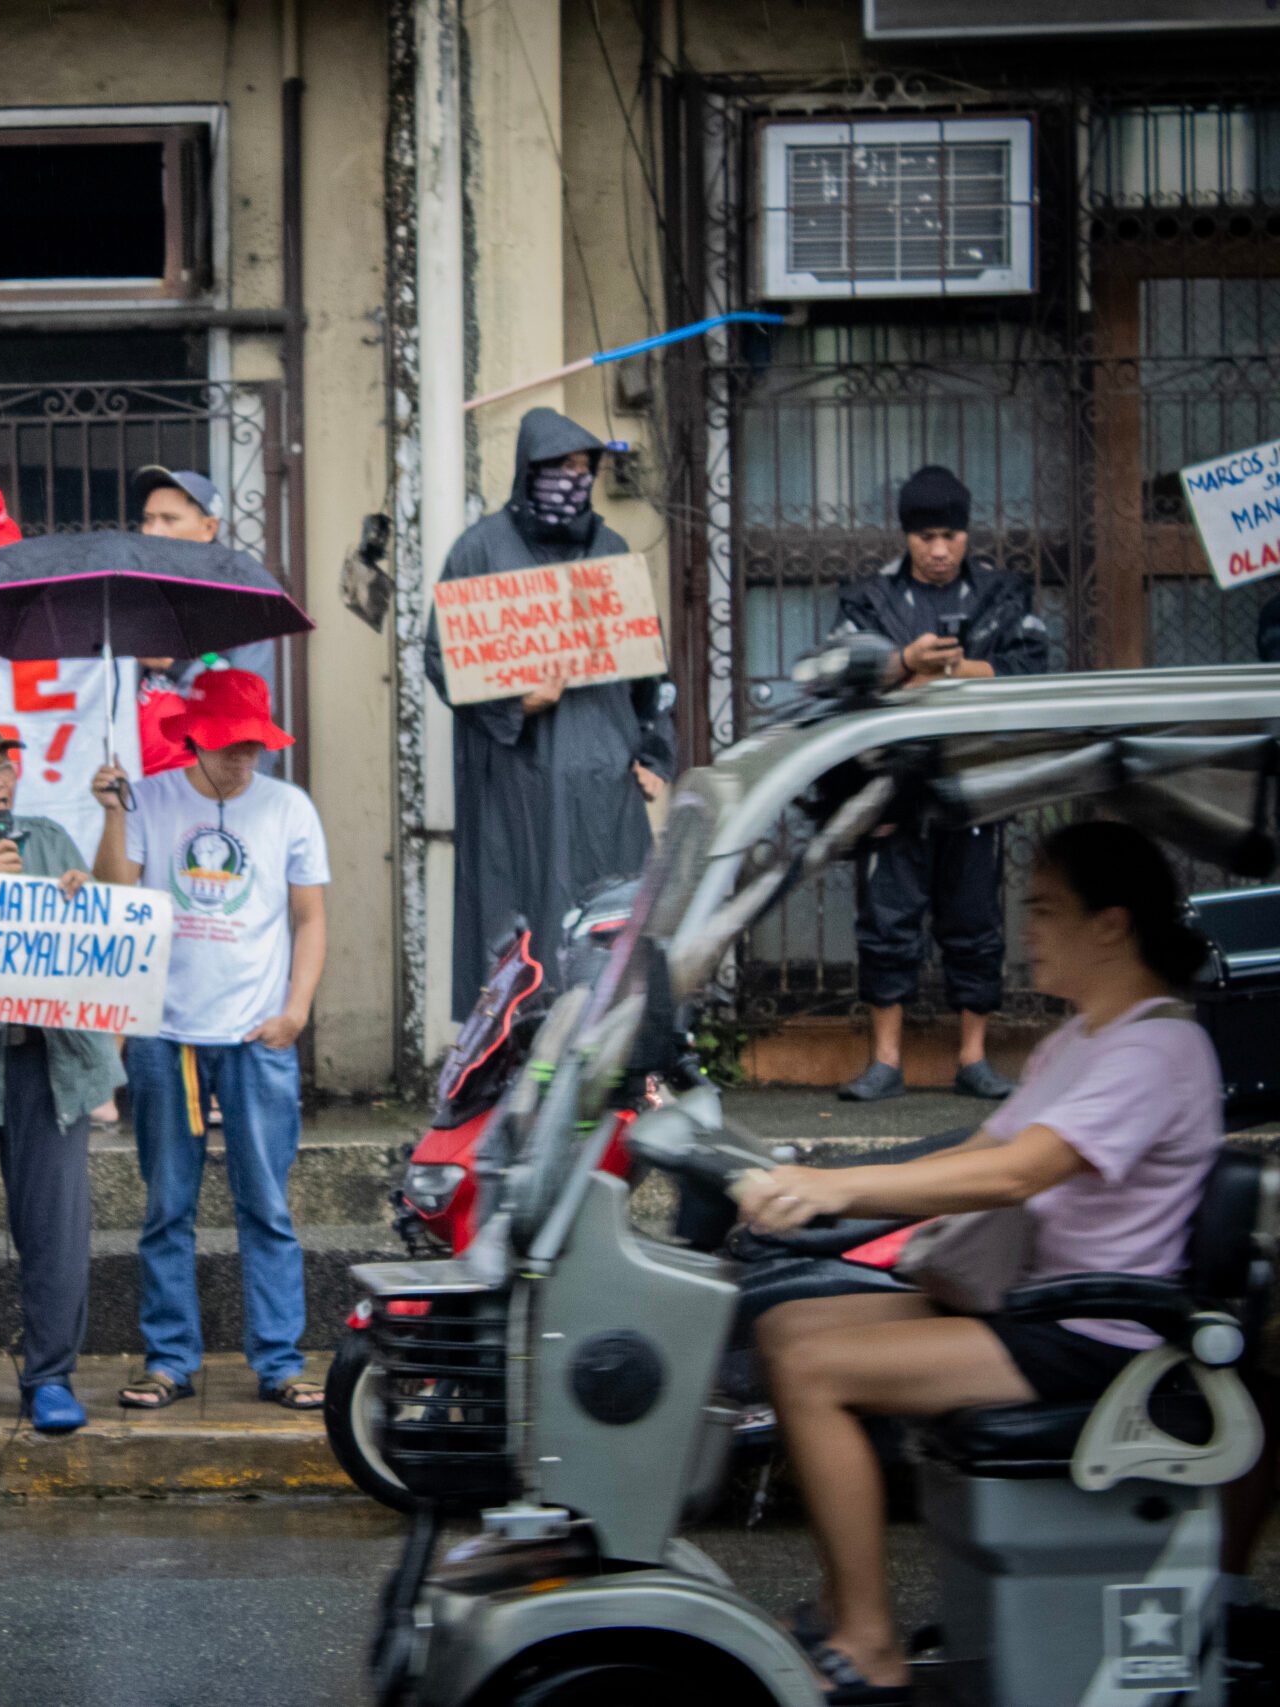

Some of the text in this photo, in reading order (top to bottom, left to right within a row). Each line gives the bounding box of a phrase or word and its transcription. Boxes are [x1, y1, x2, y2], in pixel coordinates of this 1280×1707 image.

[1187, 447, 1280, 495] MARCOS J
[570, 564, 613, 589] ANG
[1229, 539, 1280, 576] OLA
[446, 591, 623, 642] MALAWAKANG
[445, 626, 590, 670] TANGGALAN
[124, 902, 153, 925] SA
